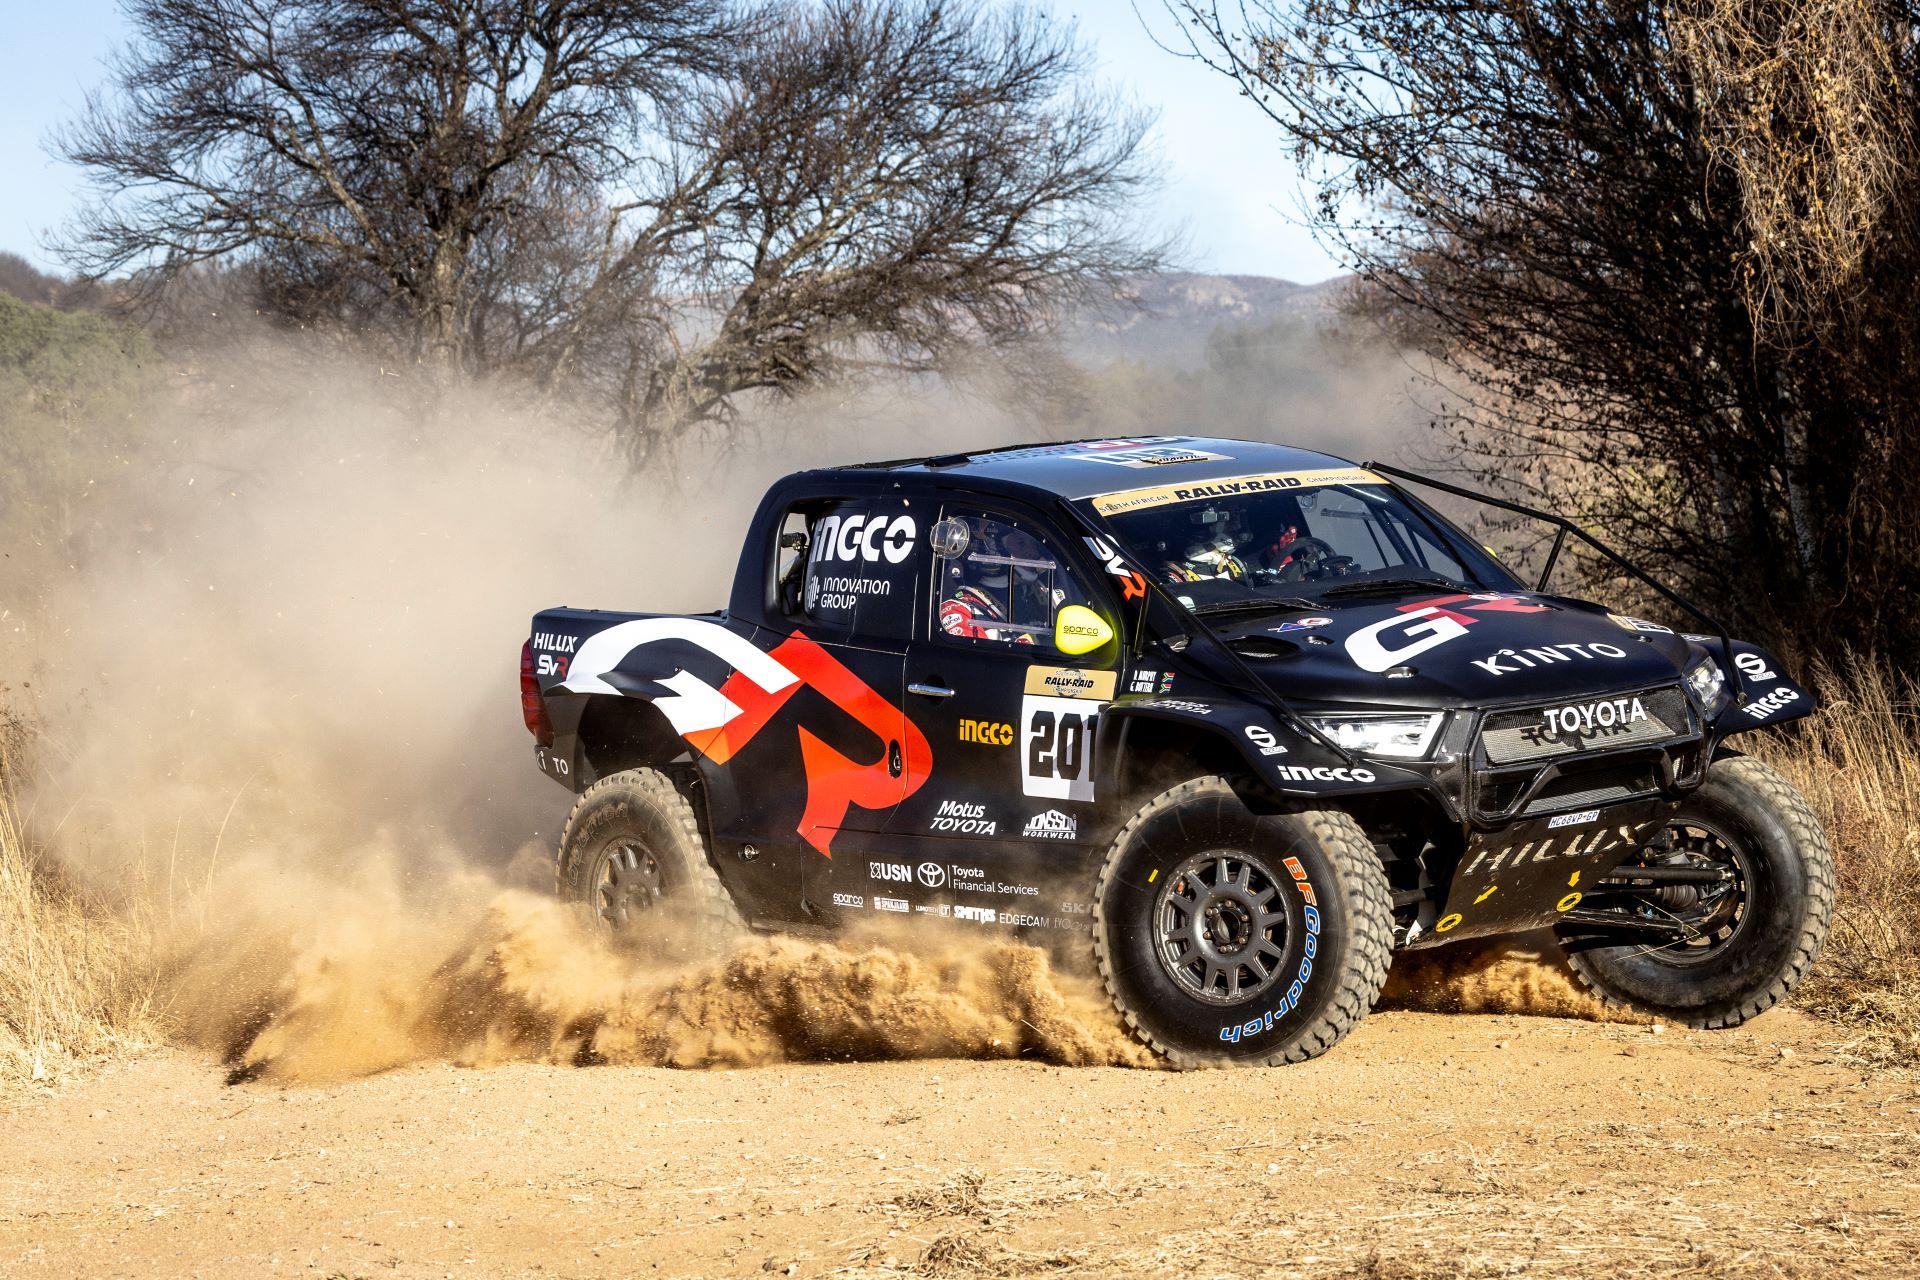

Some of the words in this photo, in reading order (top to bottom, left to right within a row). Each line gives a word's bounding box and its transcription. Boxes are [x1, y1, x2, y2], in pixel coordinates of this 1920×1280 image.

[1131, 494, 1169, 508] AFRICAN
[1173, 477, 1302, 500] RALLY-RAID
[821, 594, 857, 609] GROUP
[1063, 624, 1099, 637] sparco
[533, 632, 579, 653] HILUX
[1044, 676, 1095, 689] RALLY-RAID
[1544, 698, 1648, 733] TOYOTA
[1029, 710, 1099, 782] 201
[937, 800, 986, 819] Motus
[930, 817, 997, 836] TOYOTA
[1025, 809, 1077, 830] JONSSON
[1022, 830, 1077, 840] WORKWEAR
[1462, 820, 1653, 877] HILUX
[881, 862, 912, 883] USN
[952, 865, 985, 879] Toyota
[953, 878, 996, 893] Financial
[998, 882, 1039, 896] Services
[833, 893, 863, 906] sparco
[1000, 912, 1050, 929] EDGECAM
[1219, 856, 1321, 1043] BFGoodrich
